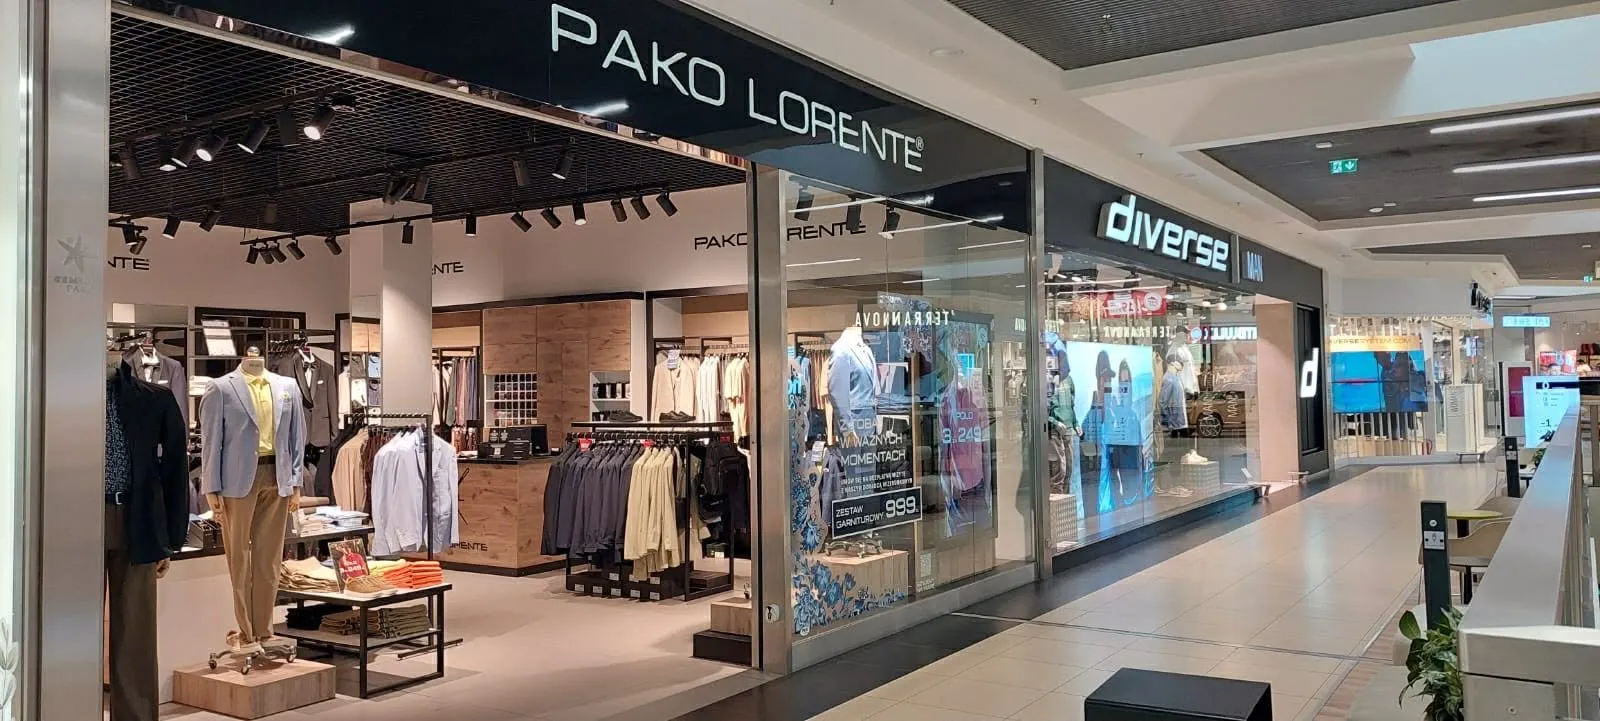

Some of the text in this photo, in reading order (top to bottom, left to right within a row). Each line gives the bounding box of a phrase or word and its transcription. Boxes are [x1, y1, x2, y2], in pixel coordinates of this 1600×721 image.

[551, 3, 726, 107] PAKO
[1105, 194, 1263, 282] diverse MAN
[432, 262, 464, 275] NTE
[841, 449, 906, 467] MOMENTACH
[835, 505, 864, 518] ZESTAW
[835, 495, 916, 529] GARNITUROWY 999
